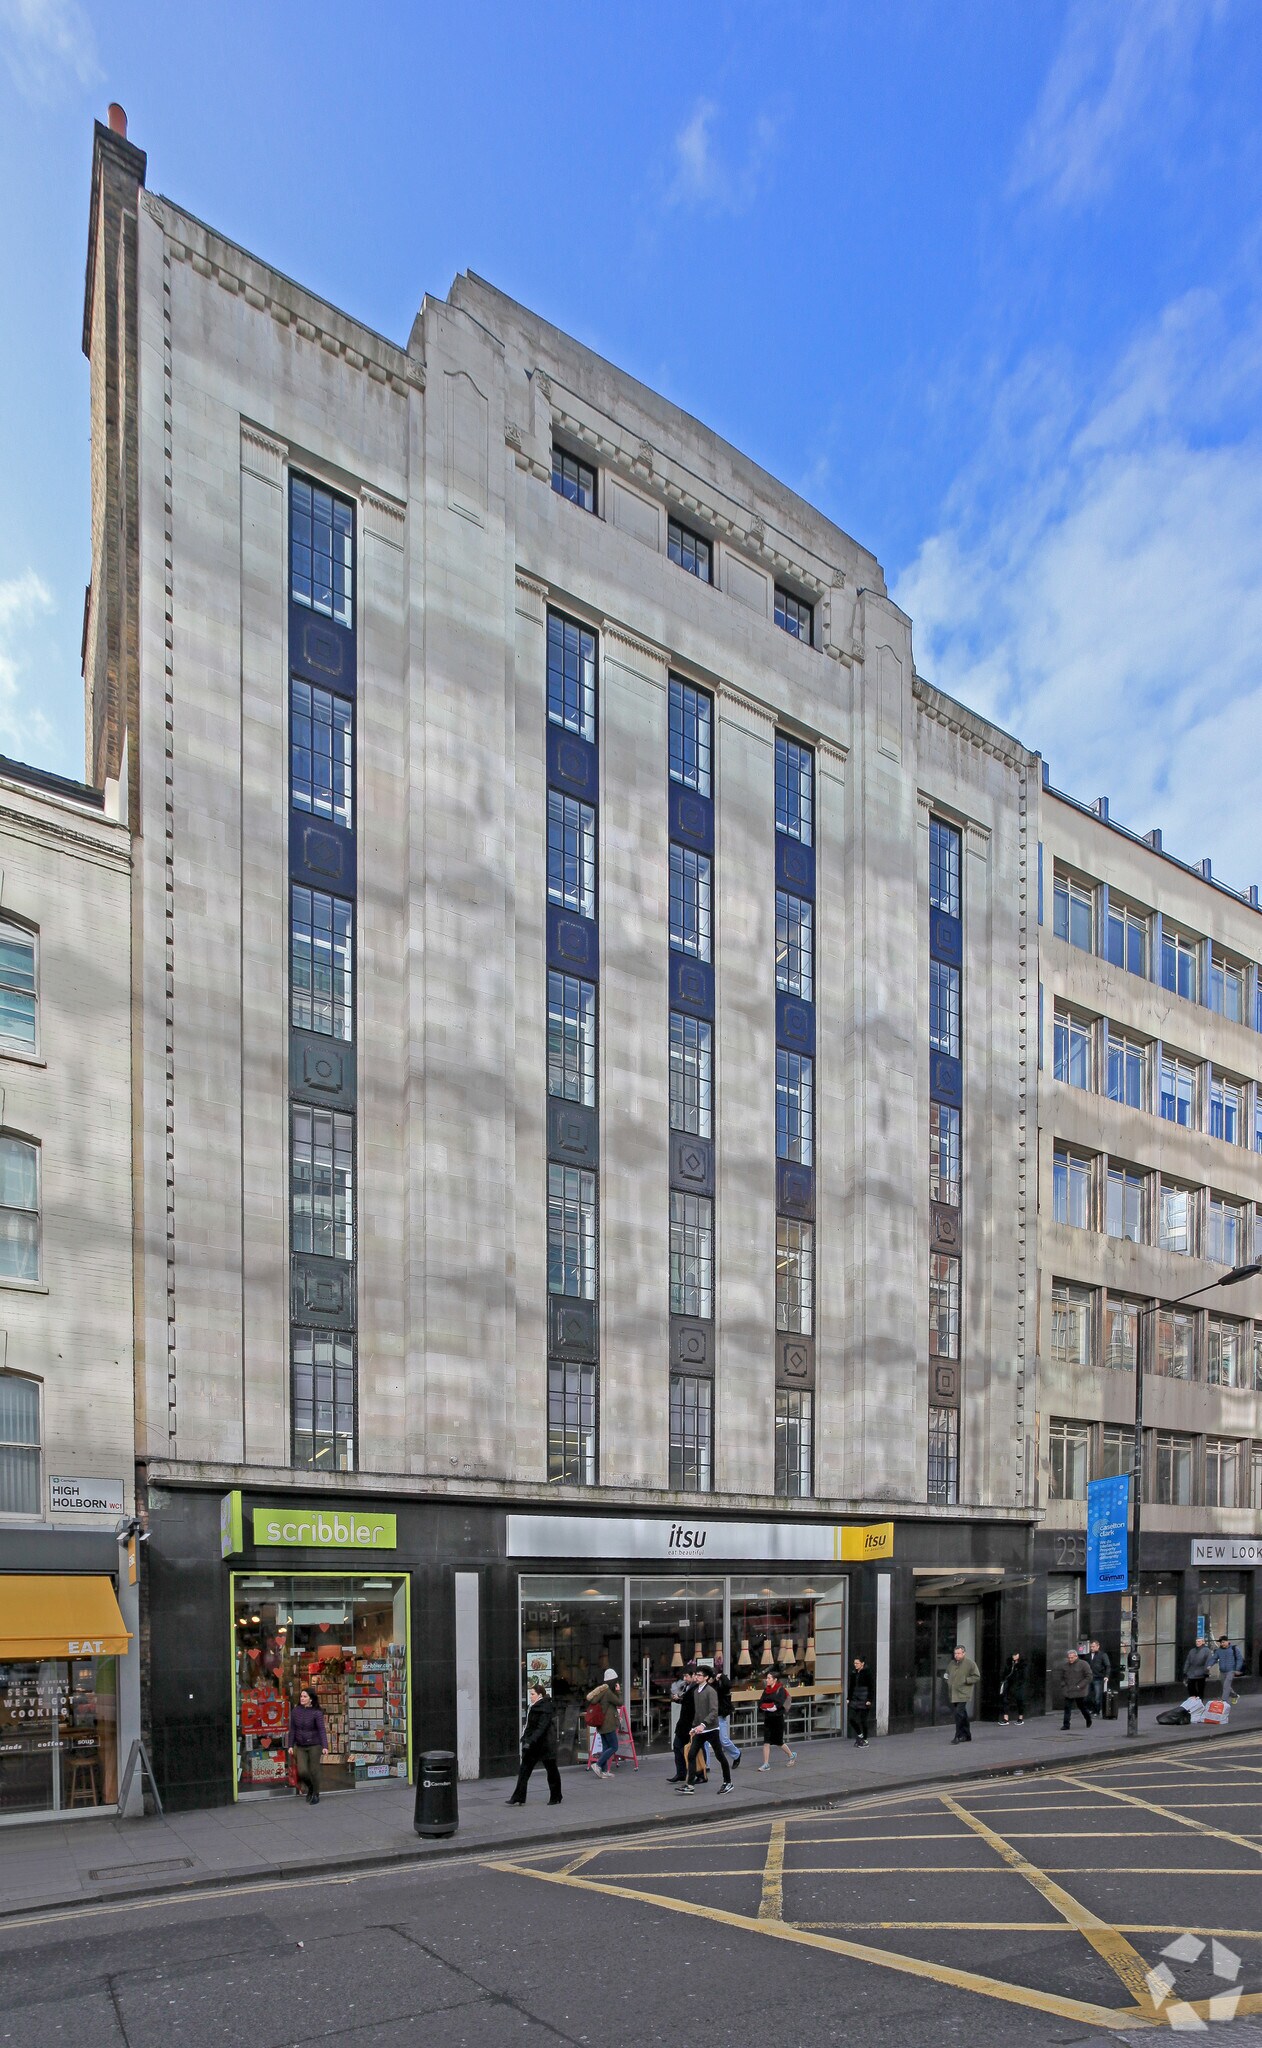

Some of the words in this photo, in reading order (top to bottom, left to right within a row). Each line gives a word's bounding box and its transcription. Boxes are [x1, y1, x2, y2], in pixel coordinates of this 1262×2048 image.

[52, 1486, 80, 1495] HIGH
[52, 1498, 107, 1508] HOLBORN
[266, 1514, 384, 1544] scribbler
[668, 1523, 707, 1548] itsu
[864, 1529, 887, 1548] itsu
[1196, 1546, 1226, 1558] NEW
[1231, 1547, 1262, 1559] LOOK
[1099, 1574, 1125, 1582] Clayman
[68, 1641, 107, 1654] EAT.
[7, 1688, 28, 1696] SEE
[36, 1686, 70, 1695] WHAT
[3, 1697, 43, 1708] WE'VE
[51, 1696, 74, 1705] GOT
[10, 1707, 68, 1718] COOKING
[241, 1700, 290, 1726] DO!
